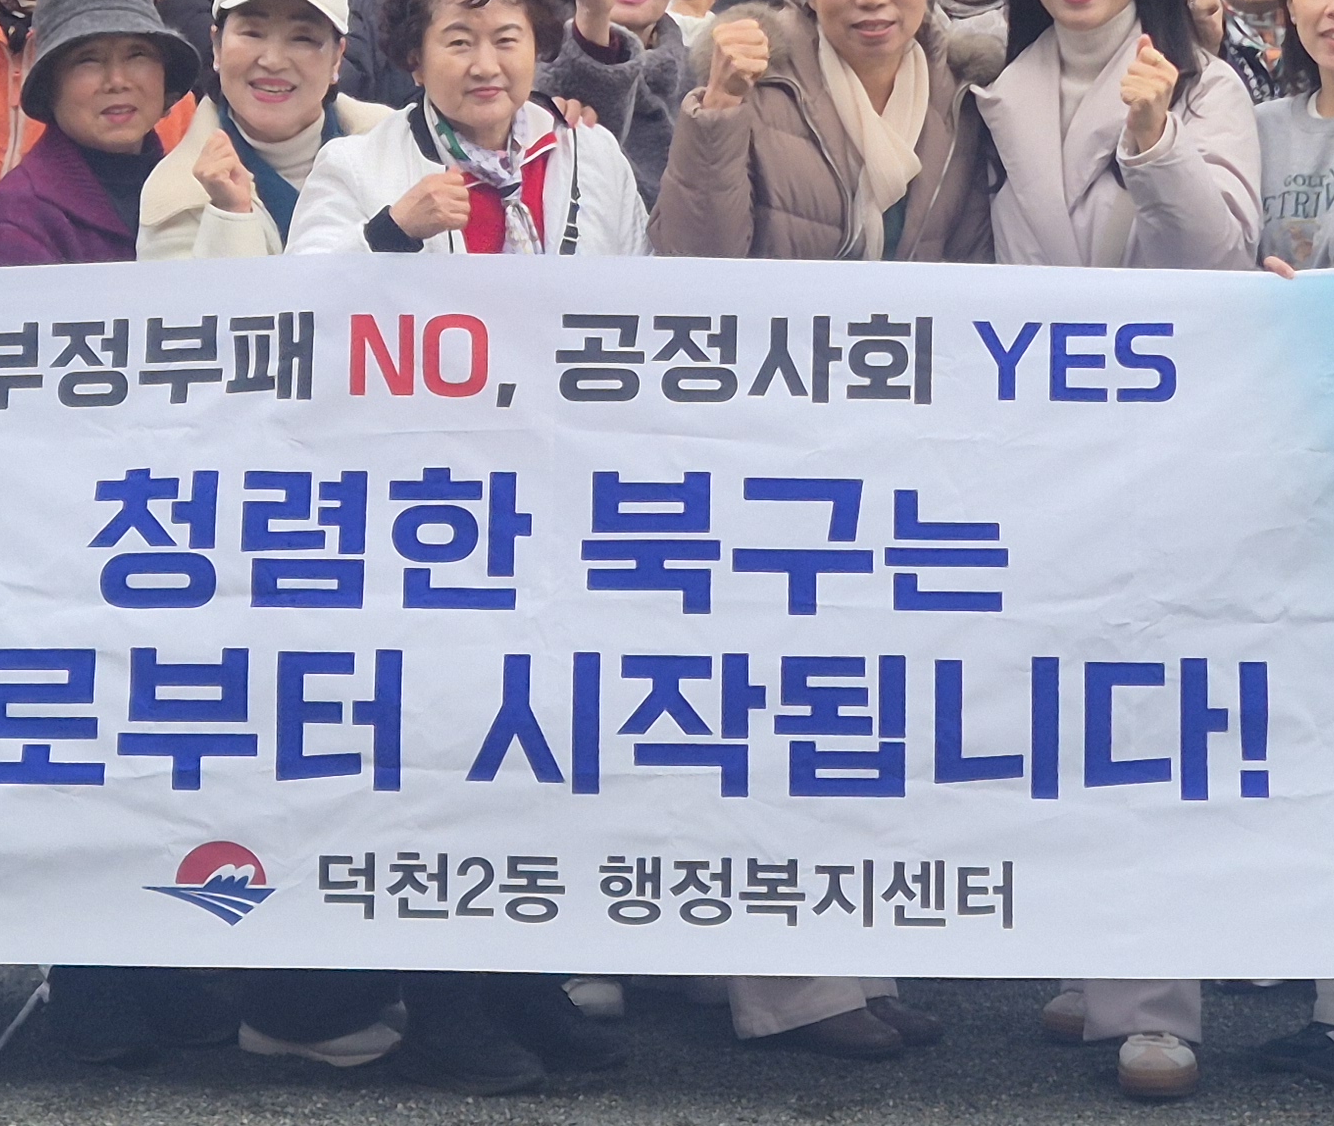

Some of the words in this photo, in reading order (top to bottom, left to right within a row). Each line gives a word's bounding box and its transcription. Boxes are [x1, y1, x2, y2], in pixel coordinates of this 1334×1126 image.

[351, 313, 516, 408] NO,
[556, 313, 933, 405] 공정사회
[972, 321, 1177, 403] YES
[88, 467, 533, 611] 청렴한
[581, 471, 1009, 616] 북구는
[465, 651, 1270, 801] 시작됩니다!
[318, 851, 566, 924] 덕천2동
[599, 855, 1014, 929] 행정복지센터
